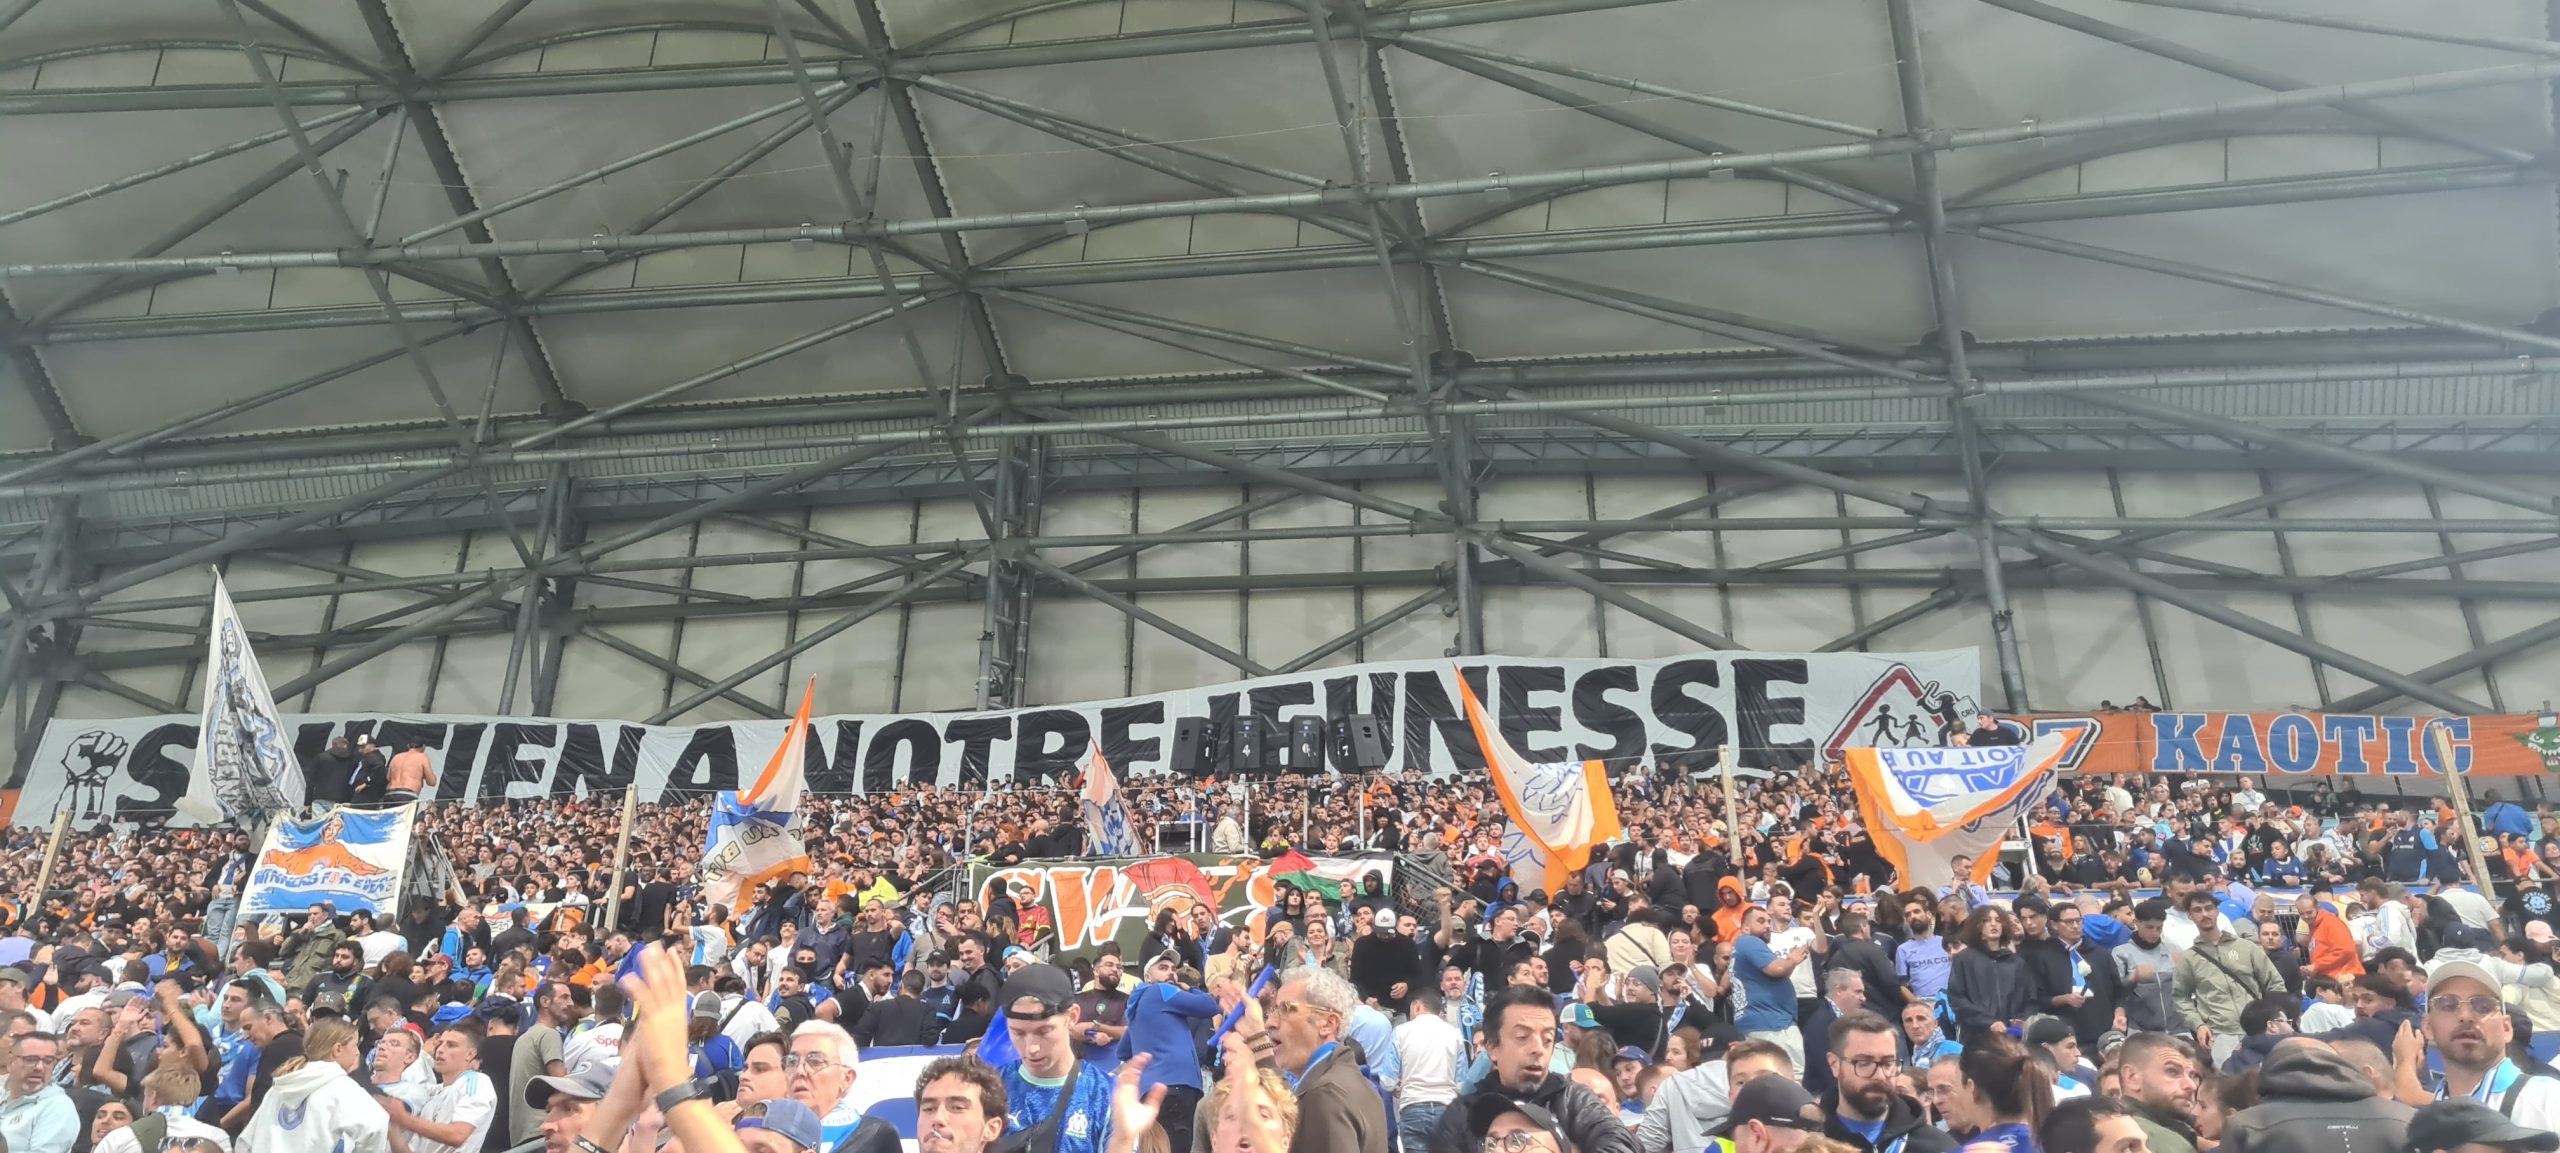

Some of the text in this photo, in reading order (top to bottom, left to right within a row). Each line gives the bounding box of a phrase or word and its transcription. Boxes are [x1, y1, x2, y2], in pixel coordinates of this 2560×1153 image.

[1961, 708, 1975, 717] CRS
[657, 725, 739, 805] A
[785, 700, 1164, 800] NOTRE
[1202, 659, 1816, 778] JEUNESSE
[1242, 744, 1251, 757] 4
[2151, 713, 2474, 776] KAOTIC
[1906, 751, 1944, 766] AU
